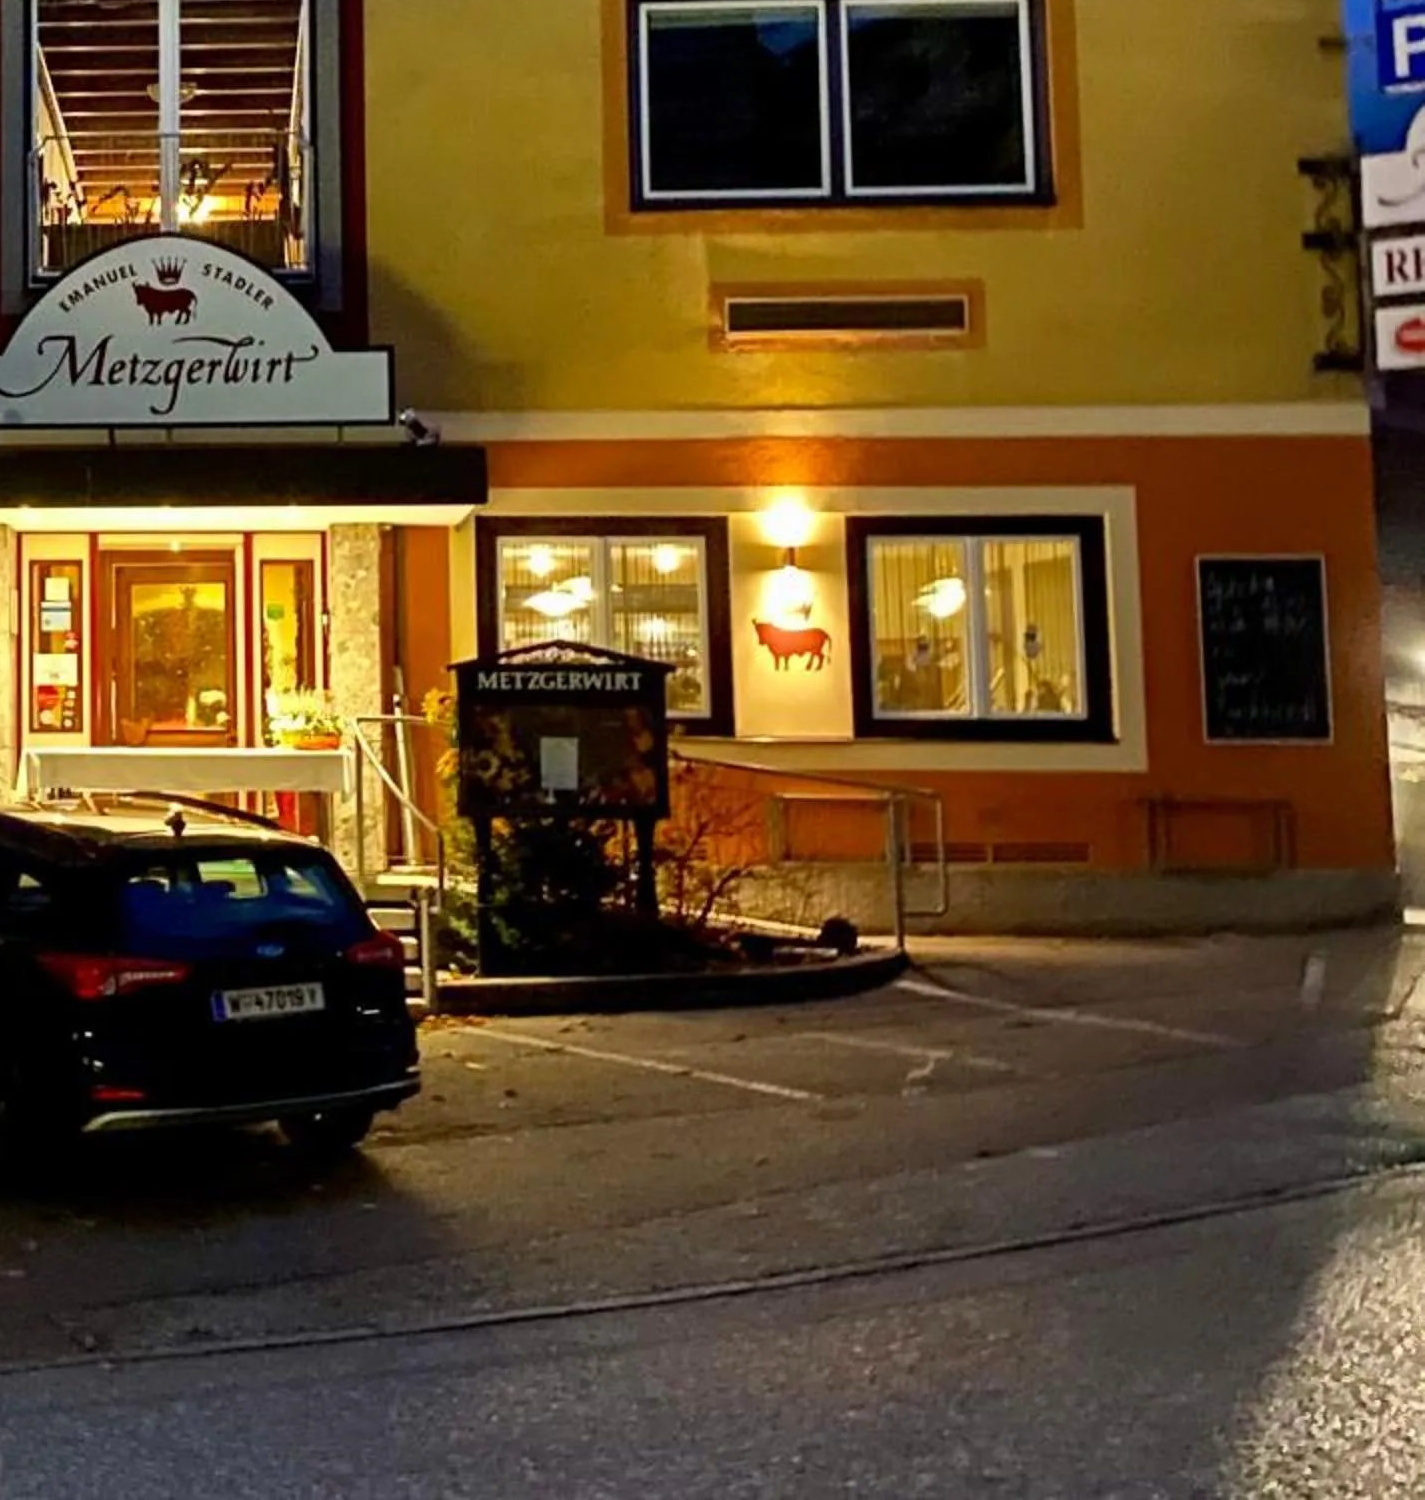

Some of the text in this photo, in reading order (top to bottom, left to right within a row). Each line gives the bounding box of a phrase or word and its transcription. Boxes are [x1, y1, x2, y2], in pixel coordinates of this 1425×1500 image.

[58, 262, 275, 313] EMANUEL STADLER
[477, 671, 642, 691] METZGERWIRT
